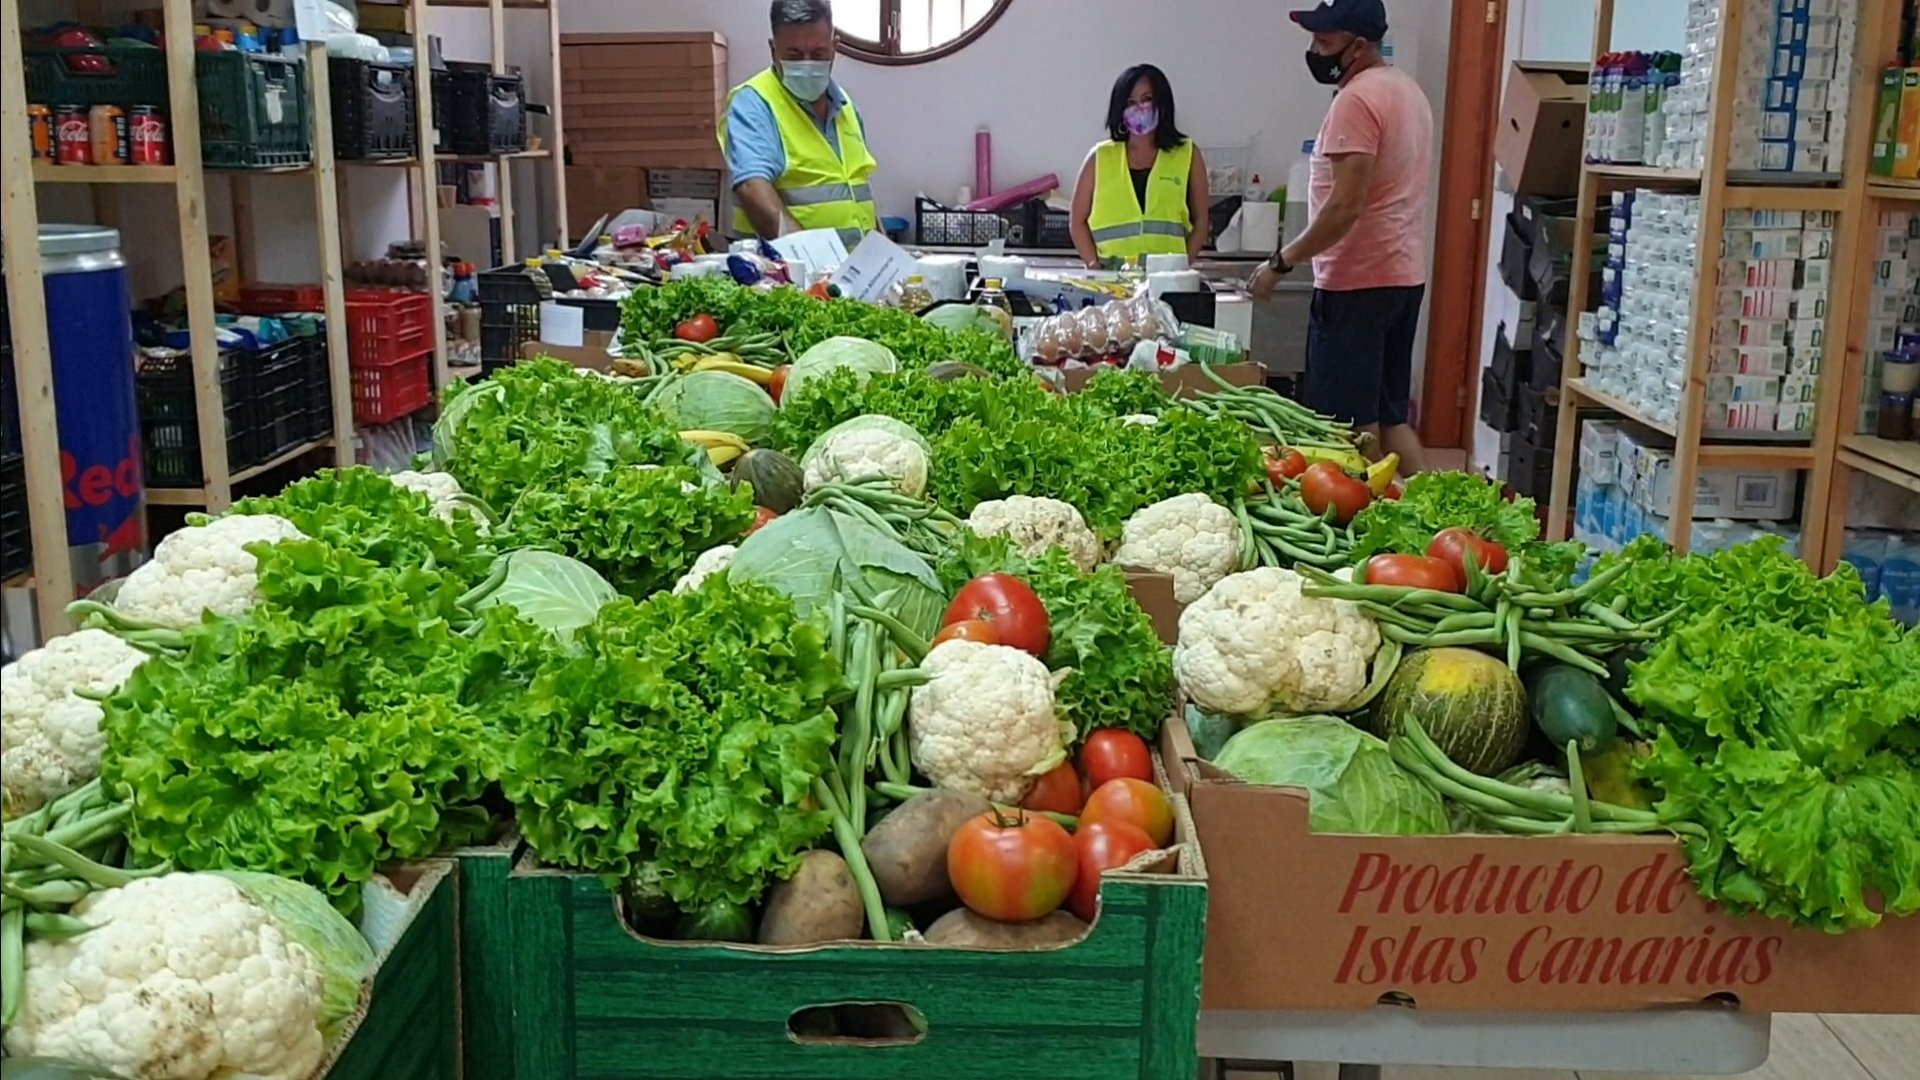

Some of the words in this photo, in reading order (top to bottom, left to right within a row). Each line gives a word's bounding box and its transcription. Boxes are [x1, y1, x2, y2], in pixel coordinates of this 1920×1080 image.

[1337, 852, 1602, 914] Producto
[1615, 852, 1688, 914] de
[1333, 924, 1487, 985] Islas
[1506, 924, 1782, 985] Canarias
